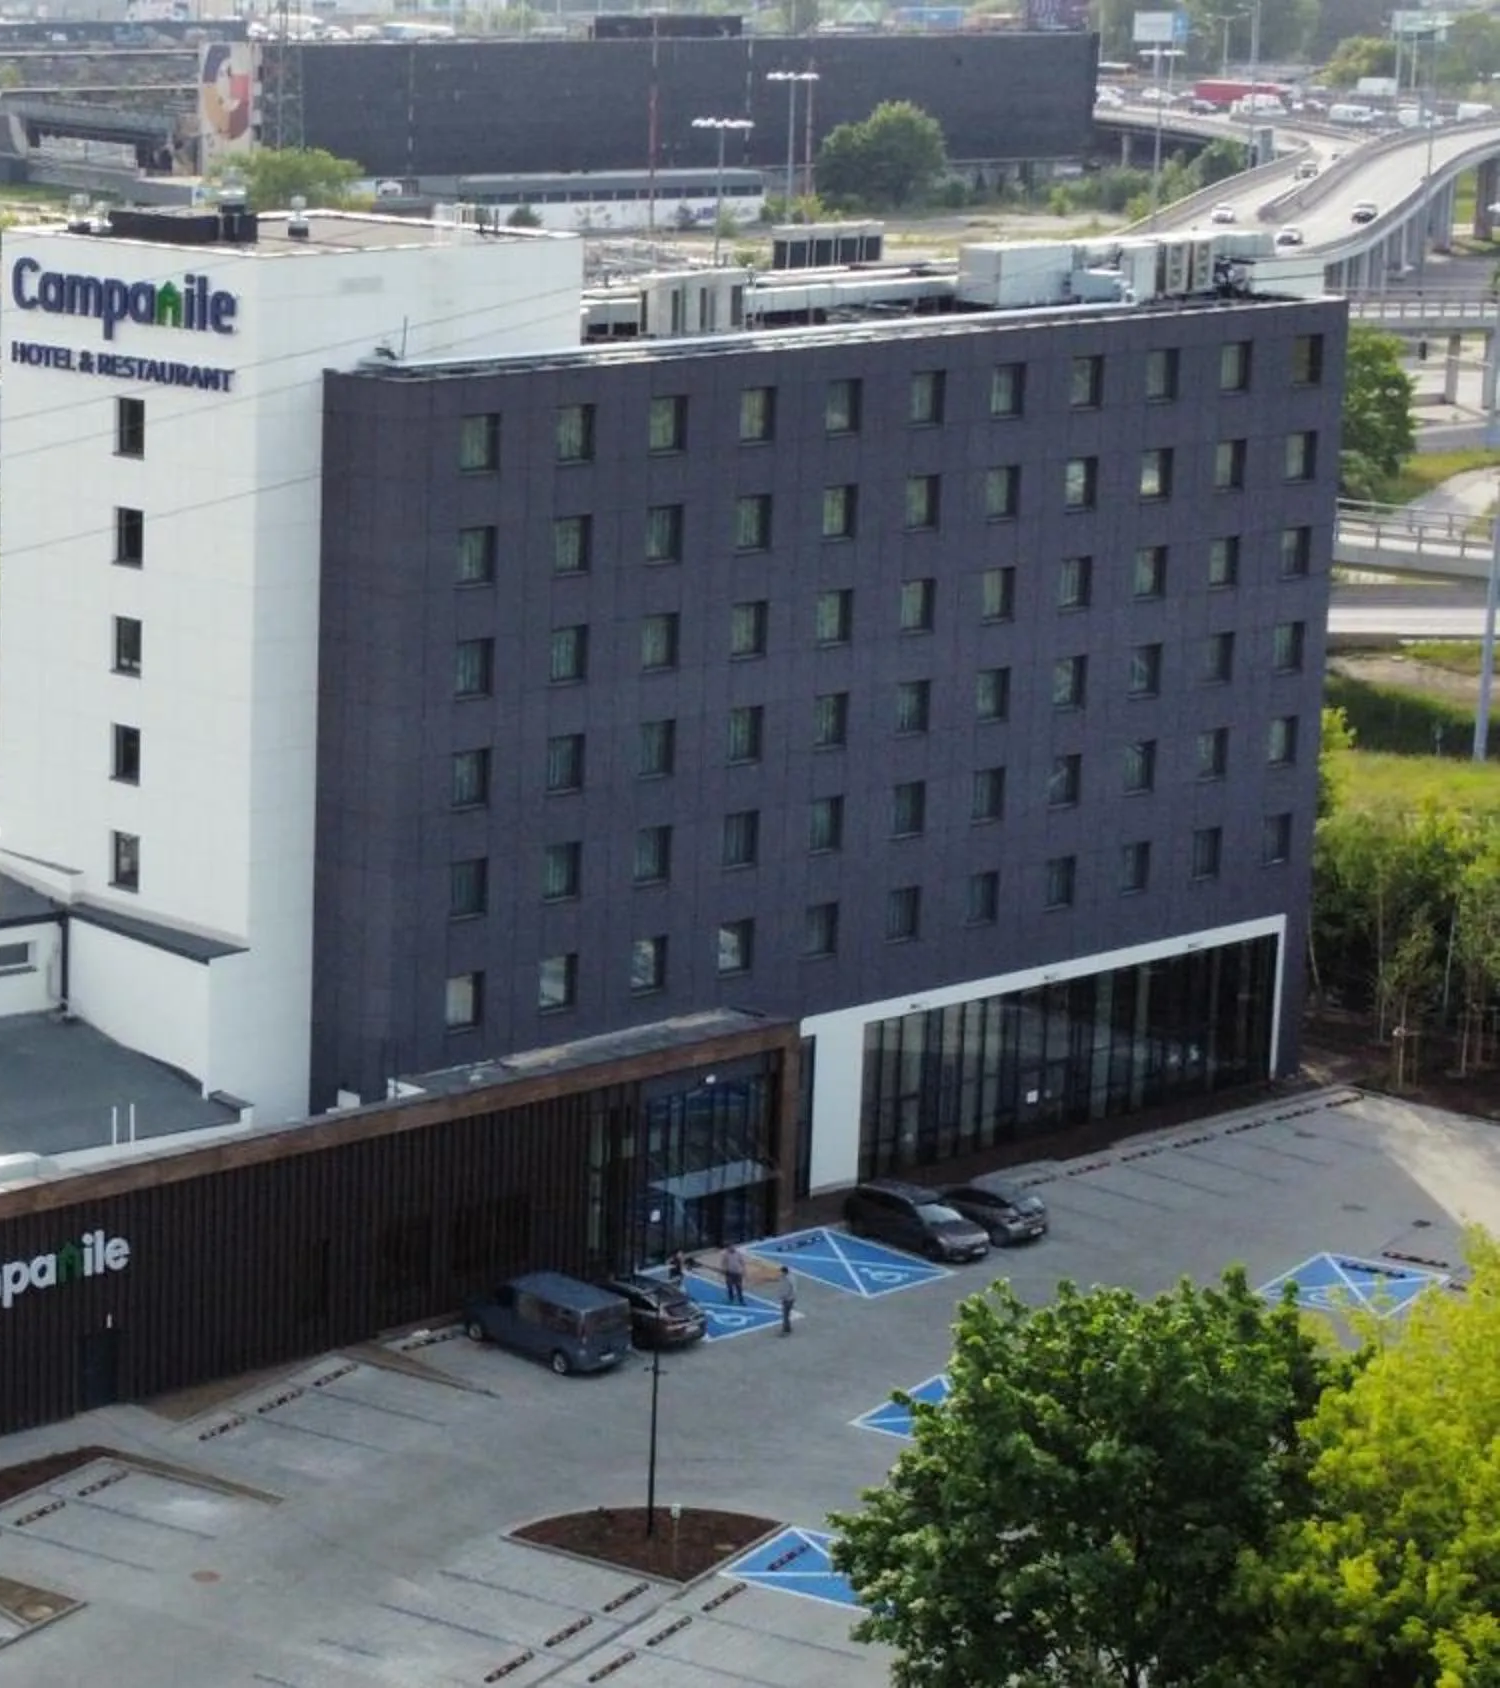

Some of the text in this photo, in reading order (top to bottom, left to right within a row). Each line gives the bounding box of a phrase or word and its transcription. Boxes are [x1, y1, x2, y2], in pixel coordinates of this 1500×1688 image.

[12, 257, 237, 341] Campanile
[11, 341, 235, 392] HOTEL & RESTAURANT
